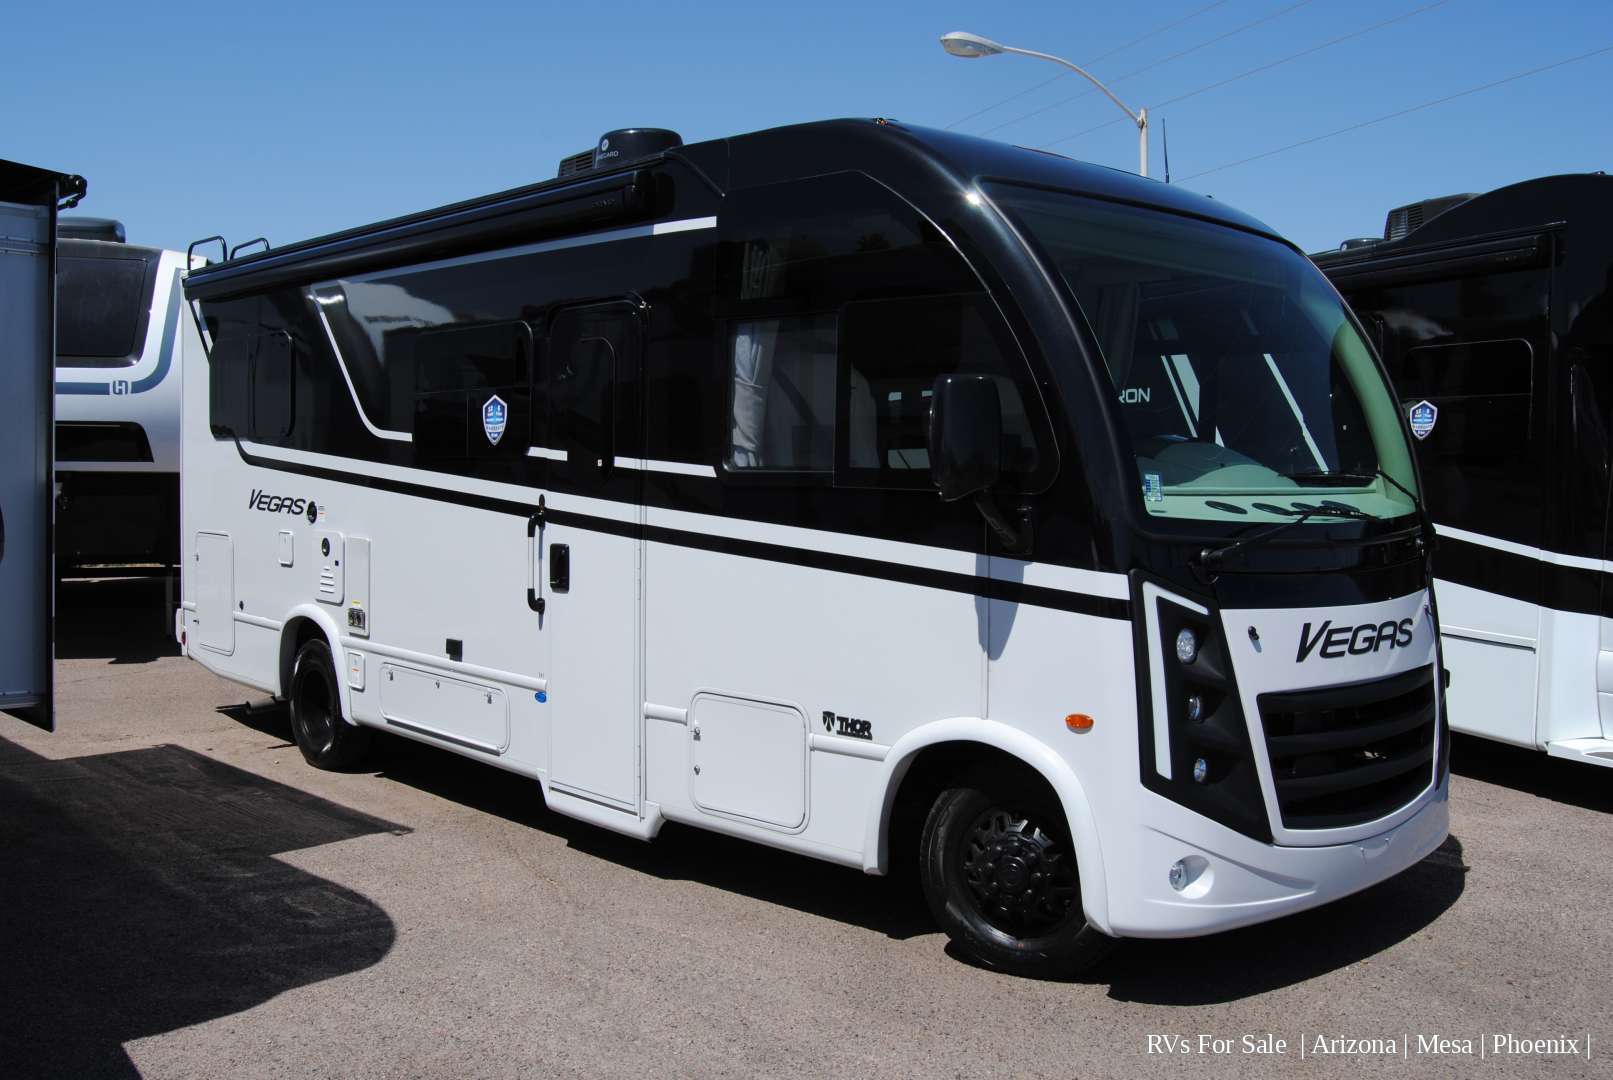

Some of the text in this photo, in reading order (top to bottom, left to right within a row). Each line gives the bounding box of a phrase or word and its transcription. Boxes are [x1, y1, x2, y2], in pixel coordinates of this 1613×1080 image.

[249, 488, 306, 515] VEGAS
[1295, 617, 1414, 664] VEGAS
[836, 715, 873, 741] THOR
